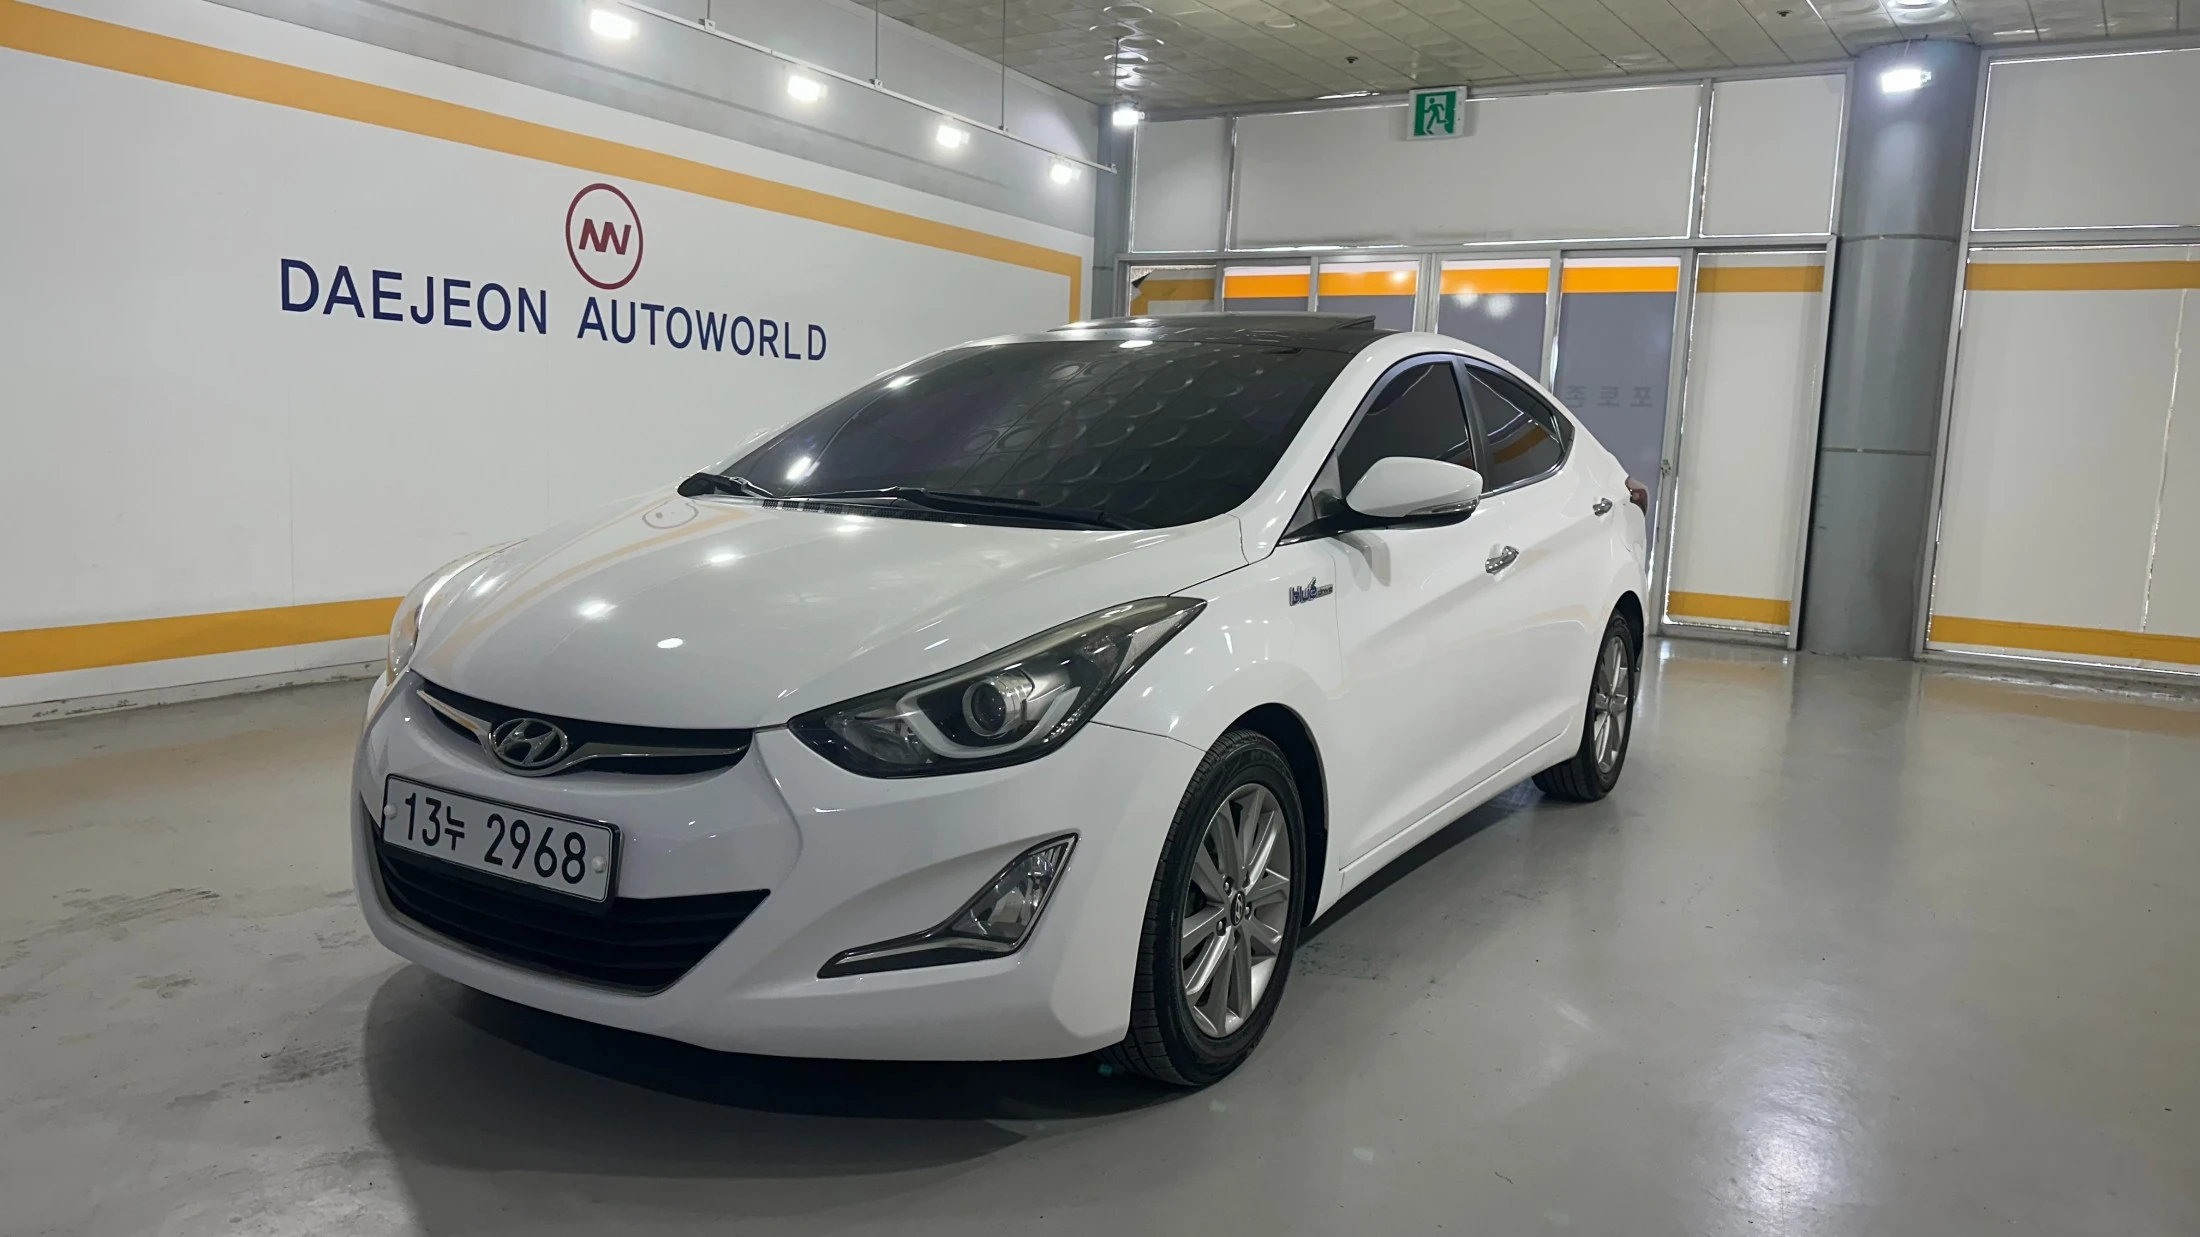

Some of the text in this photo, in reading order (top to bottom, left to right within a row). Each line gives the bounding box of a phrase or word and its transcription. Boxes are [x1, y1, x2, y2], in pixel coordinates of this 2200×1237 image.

[281, 258, 827, 361] DAEJEON AUTOWORLD
[1289, 577, 1317, 606] blue
[405, 792, 586, 884] 13누 2968
